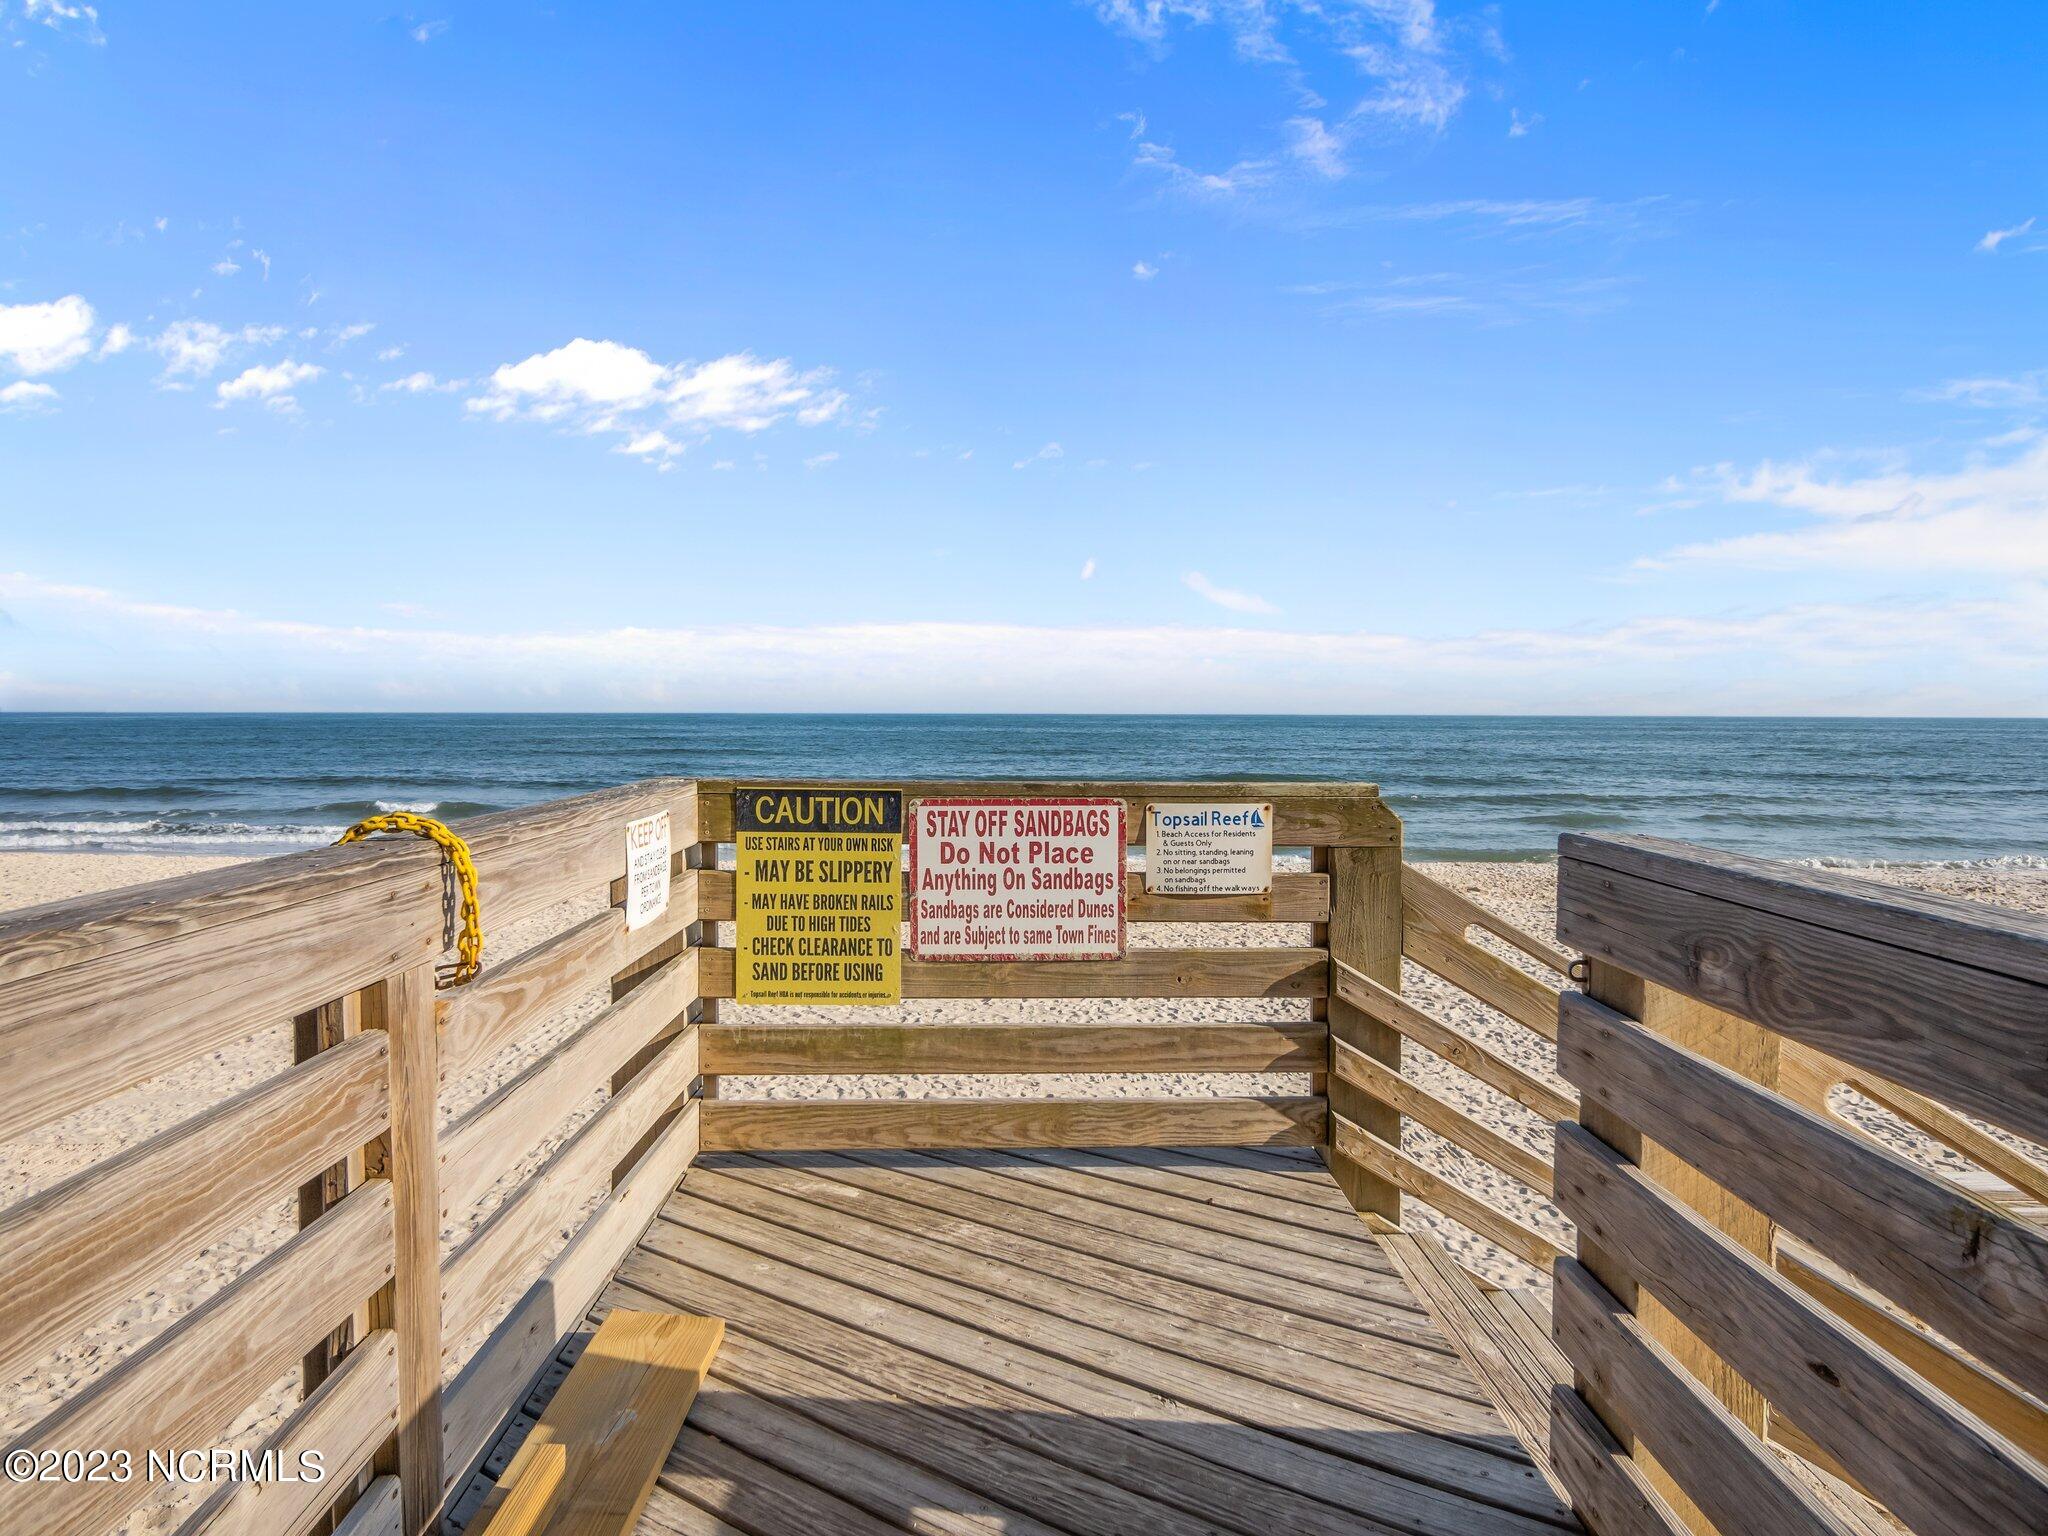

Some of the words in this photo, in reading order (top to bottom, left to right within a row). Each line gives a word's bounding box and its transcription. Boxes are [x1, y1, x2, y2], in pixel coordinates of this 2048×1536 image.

[755, 796, 884, 825] CAUTION
[1151, 811, 1207, 829] Topsail
[1211, 810, 1249, 826] Reef
[926, 810, 970, 837] STAY
[975, 810, 1008, 837] OFF
[1014, 810, 1110, 837] SANDBAGS
[630, 820, 653, 850] KEEP
[745, 837, 763, 851] USE
[766, 837, 800, 851] STAIRS
[803, 837, 816, 851] AT
[818, 837, 843, 851] YOUR
[846, 837, 868, 851] OWN
[871, 838, 894, 852] RISK
[1196, 840, 1212, 848] Only
[940, 842, 970, 864] Do
[979, 842, 1020, 864] Not
[1029, 842, 1094, 864] Place
[1199, 858, 1230, 866] sandbags
[1230, 849, 1254, 858] leaning
[755, 860, 790, 882] MAY
[795, 860, 814, 882] BE
[818, 860, 894, 884] SLIPPERY
[1174, 867, 1211, 876] belongings
[1212, 867, 1246, 876] permitted
[1174, 876, 1206, 884] sandbags
[922, 868, 997, 896] Anything
[1003, 867, 1026, 890] On
[1031, 867, 1114, 896] Sandbags
[1174, 885, 1198, 894] fishing
[752, 894, 777, 910] MAY
[780, 894, 810, 910] HAVE
[813, 894, 858, 910] BROKEN
[861, 894, 894, 910] RAILS
[921, 900, 979, 924] Sandbags
[983, 904, 1002, 918] are
[1006, 899, 1074, 918] Considered
[1078, 899, 1115, 918] Dunes
[766, 916, 788, 932] DUE
[791, 916, 805, 932] TO
[808, 916, 836, 932] HIGH
[839, 916, 871, 932] TIDES
[752, 937, 795, 956] CHECK
[798, 937, 873, 956] CLEARANCE
[876, 938, 893, 956] TO
[920, 926, 940, 945] and
[944, 931, 961, 945] are
[964, 925, 1006, 950] Subject
[1009, 927, 1020, 944] to
[1023, 930, 1052, 944] same
[1056, 924, 1084, 944] Town
[1088, 924, 1116, 944] Fines
[752, 962, 788, 981] SAND
[792, 962, 840, 981] BEFORE
[844, 962, 884, 981] USING
